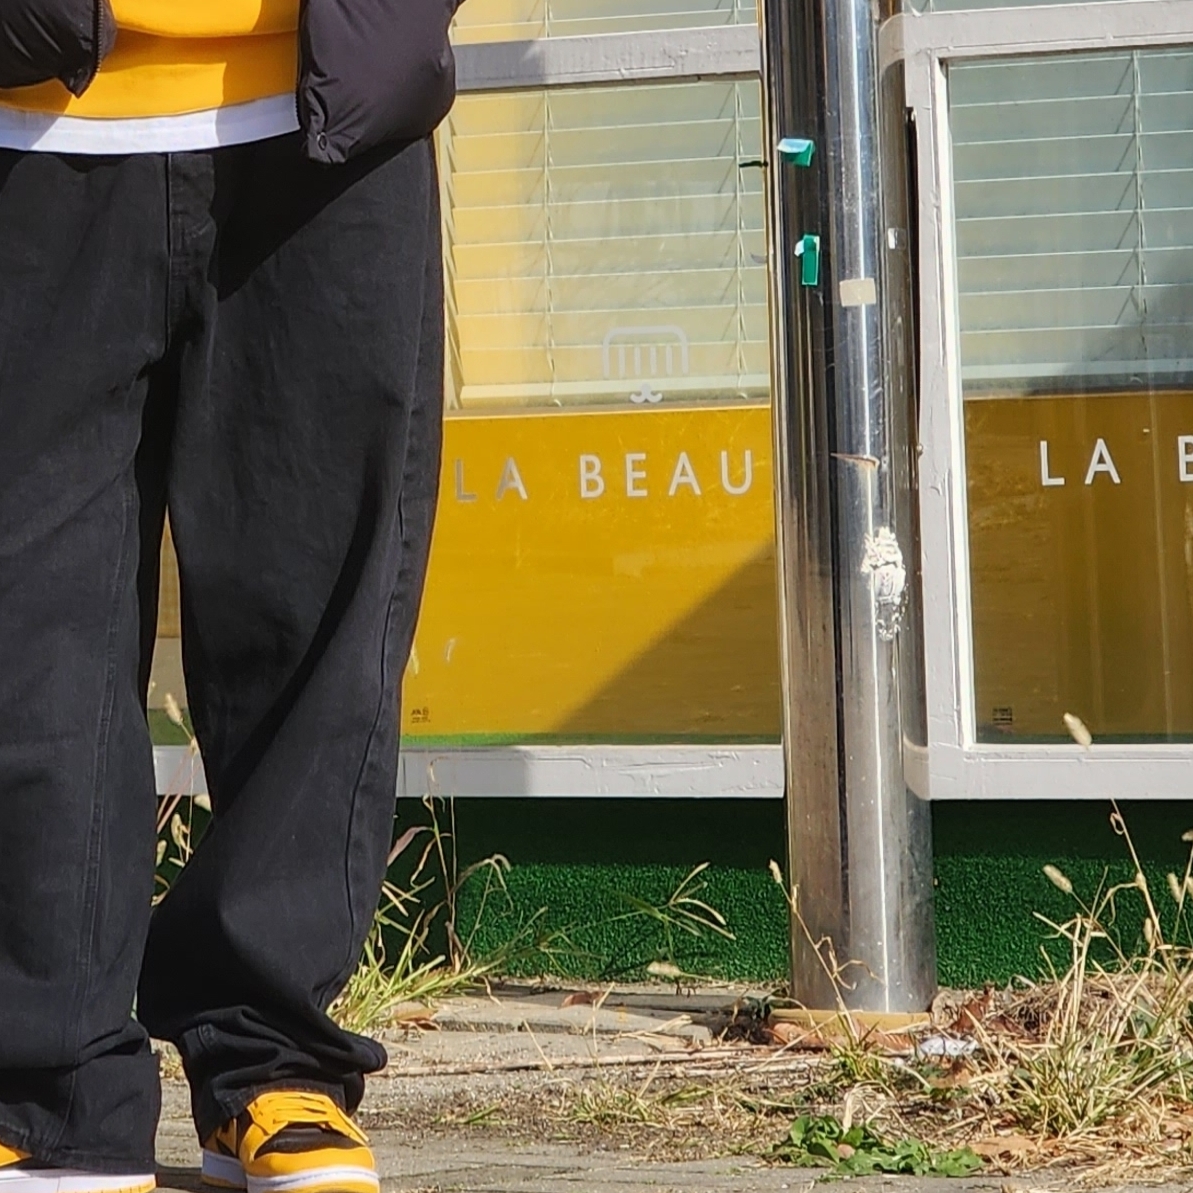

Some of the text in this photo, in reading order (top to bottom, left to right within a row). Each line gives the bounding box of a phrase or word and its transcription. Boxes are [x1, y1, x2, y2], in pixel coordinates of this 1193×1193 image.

[454, 450, 753, 502] LA BEAU
[1039, 438, 1121, 487] LA
